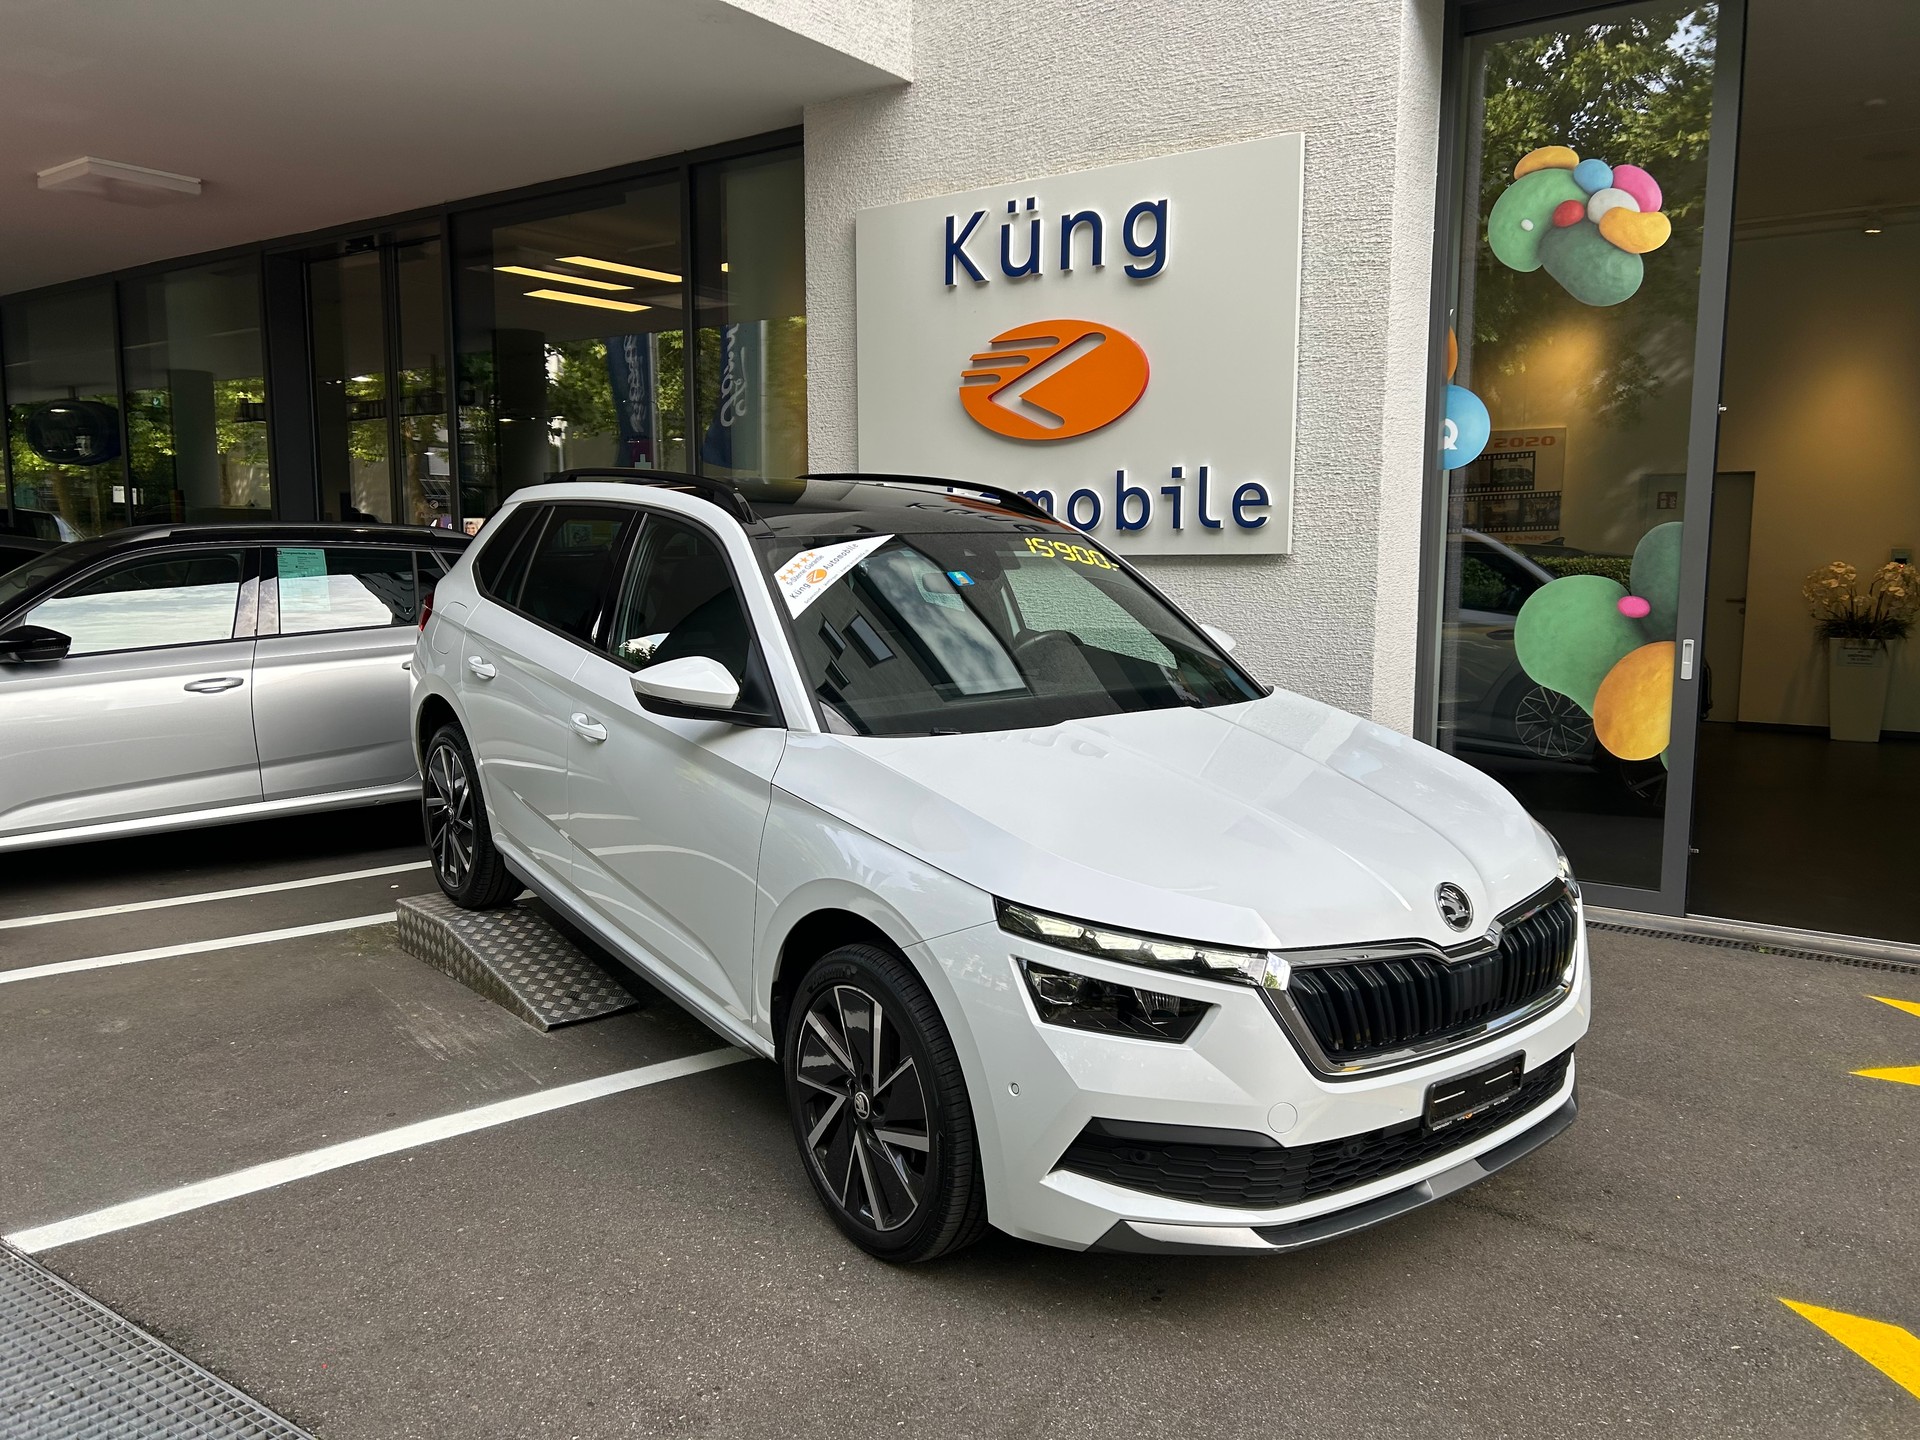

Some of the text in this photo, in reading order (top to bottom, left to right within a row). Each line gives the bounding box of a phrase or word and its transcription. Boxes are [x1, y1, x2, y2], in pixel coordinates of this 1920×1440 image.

[943, 197, 1171, 286] Küng
[1493, 436, 1556, 449] 2020
[1000, 465, 1273, 532] mobile
[1504, 534, 1552, 542] DANKE
[789, 583, 812, 600] Küng
[823, 543, 859, 571] Automobile
